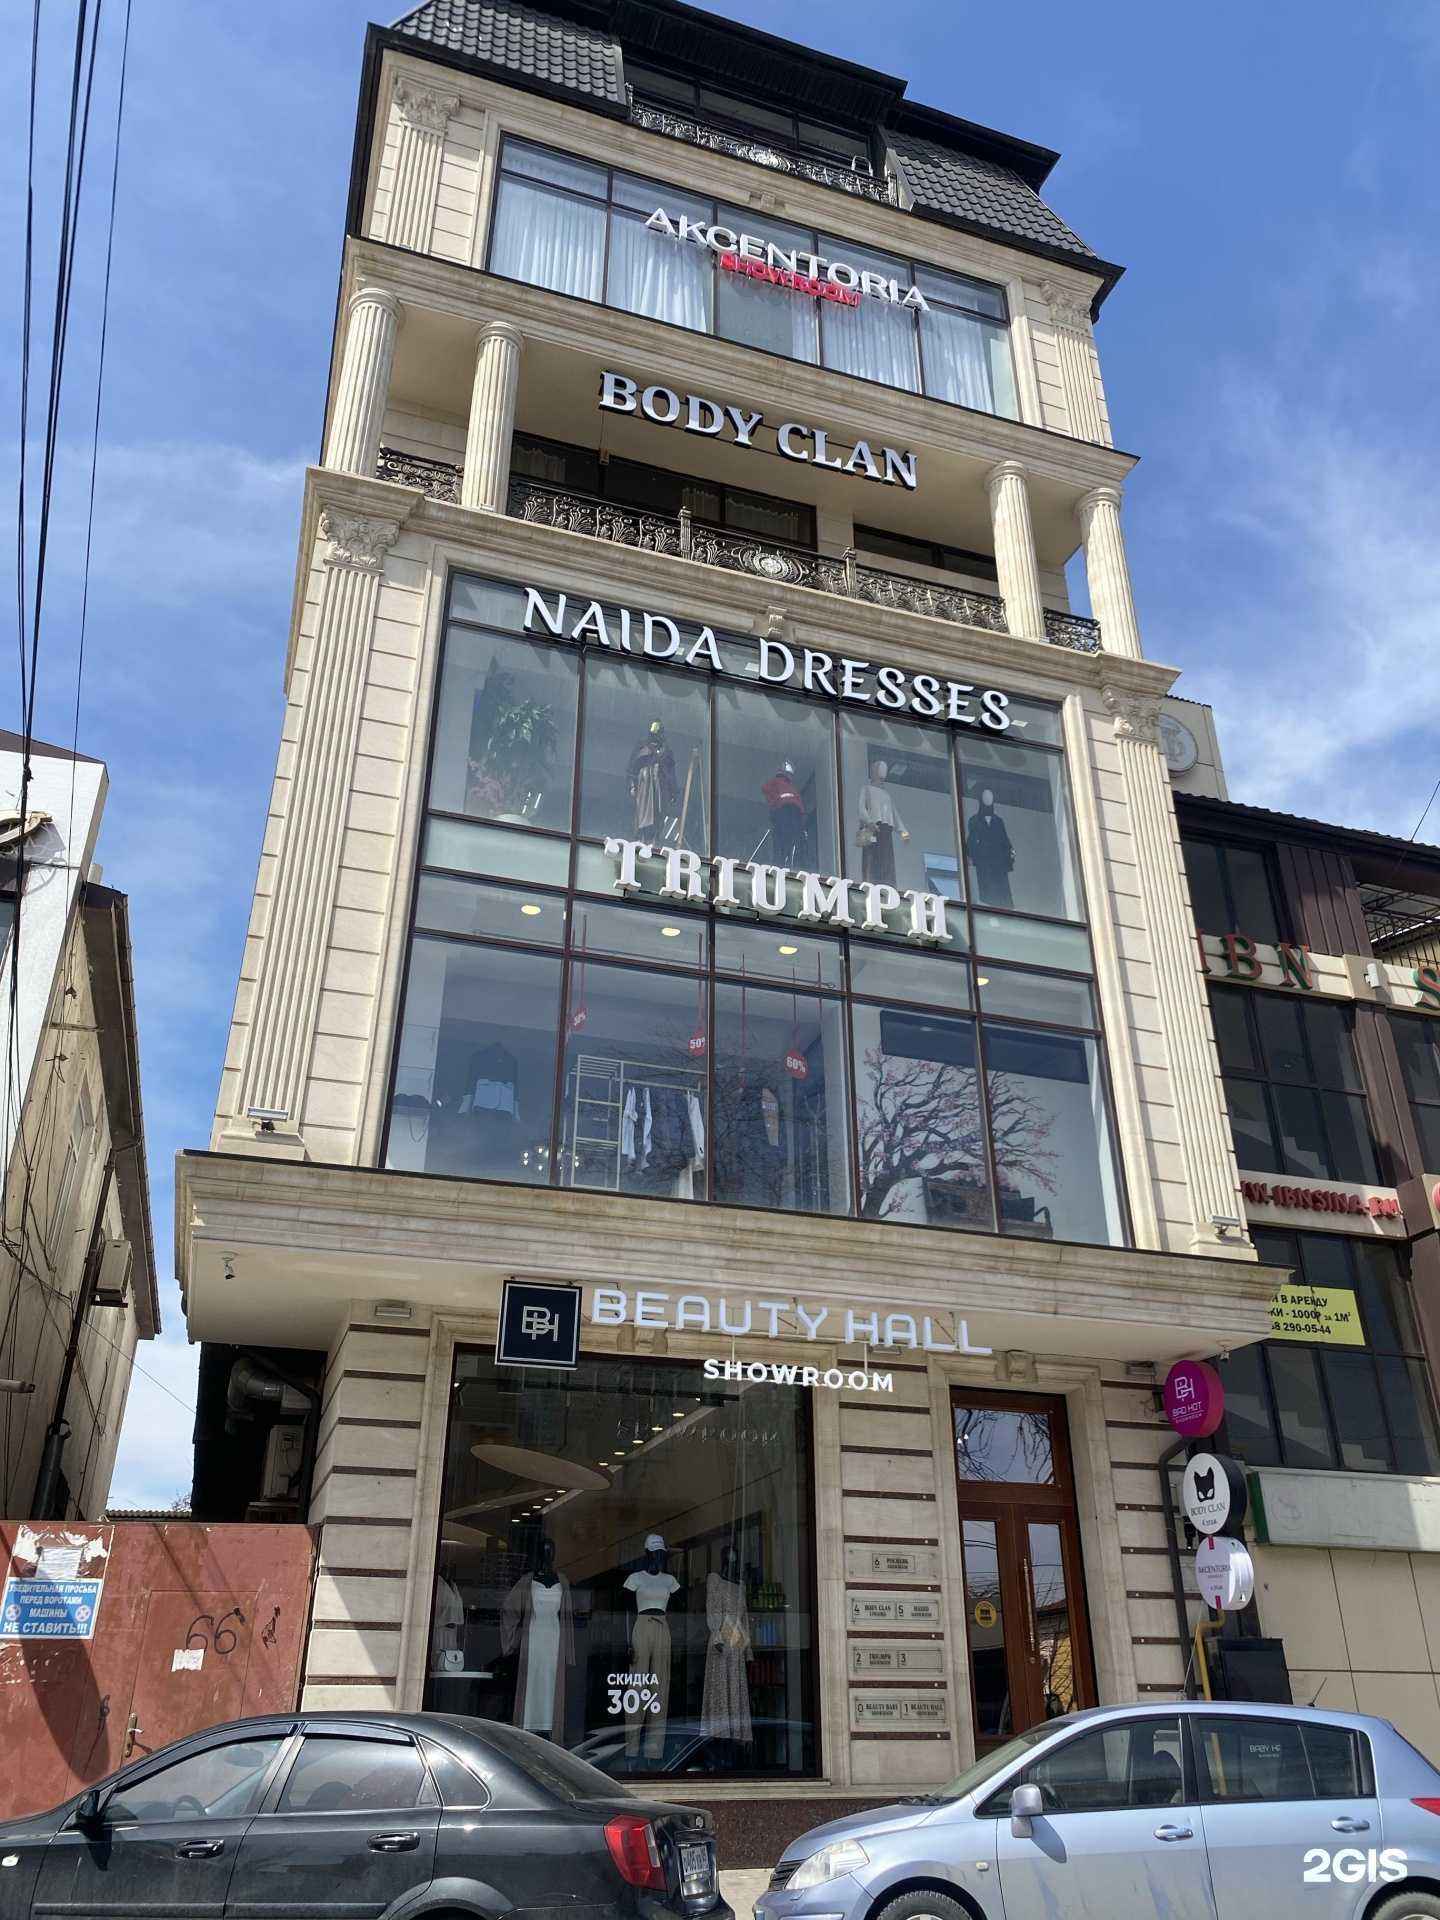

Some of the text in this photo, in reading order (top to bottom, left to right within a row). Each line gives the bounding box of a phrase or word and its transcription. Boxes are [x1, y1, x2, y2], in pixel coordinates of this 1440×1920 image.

[644, 207, 931, 312] AKCENTORIA
[599, 370, 919, 490] BODY CLAN
[523, 587, 1012, 731] NAIDA DRESSES
[603, 836, 954, 944] TRIUMPH
[1290, 1295, 1328, 1307] АРЕНДУ
[591, 1288, 993, 1355] BEAUTY HALL
[1283, 1322, 1332, 1335] 290-05-44
[702, 1357, 894, 1393] SHOWROOM
[29, 1607, 68, 1618] МАШИНЫ
[2, 1622, 88, 1634] НЕ СТАВИТЬ!!!
[607, 1673, 659, 1687] СКИДКА
[607, 1689, 661, 1714] 30%
